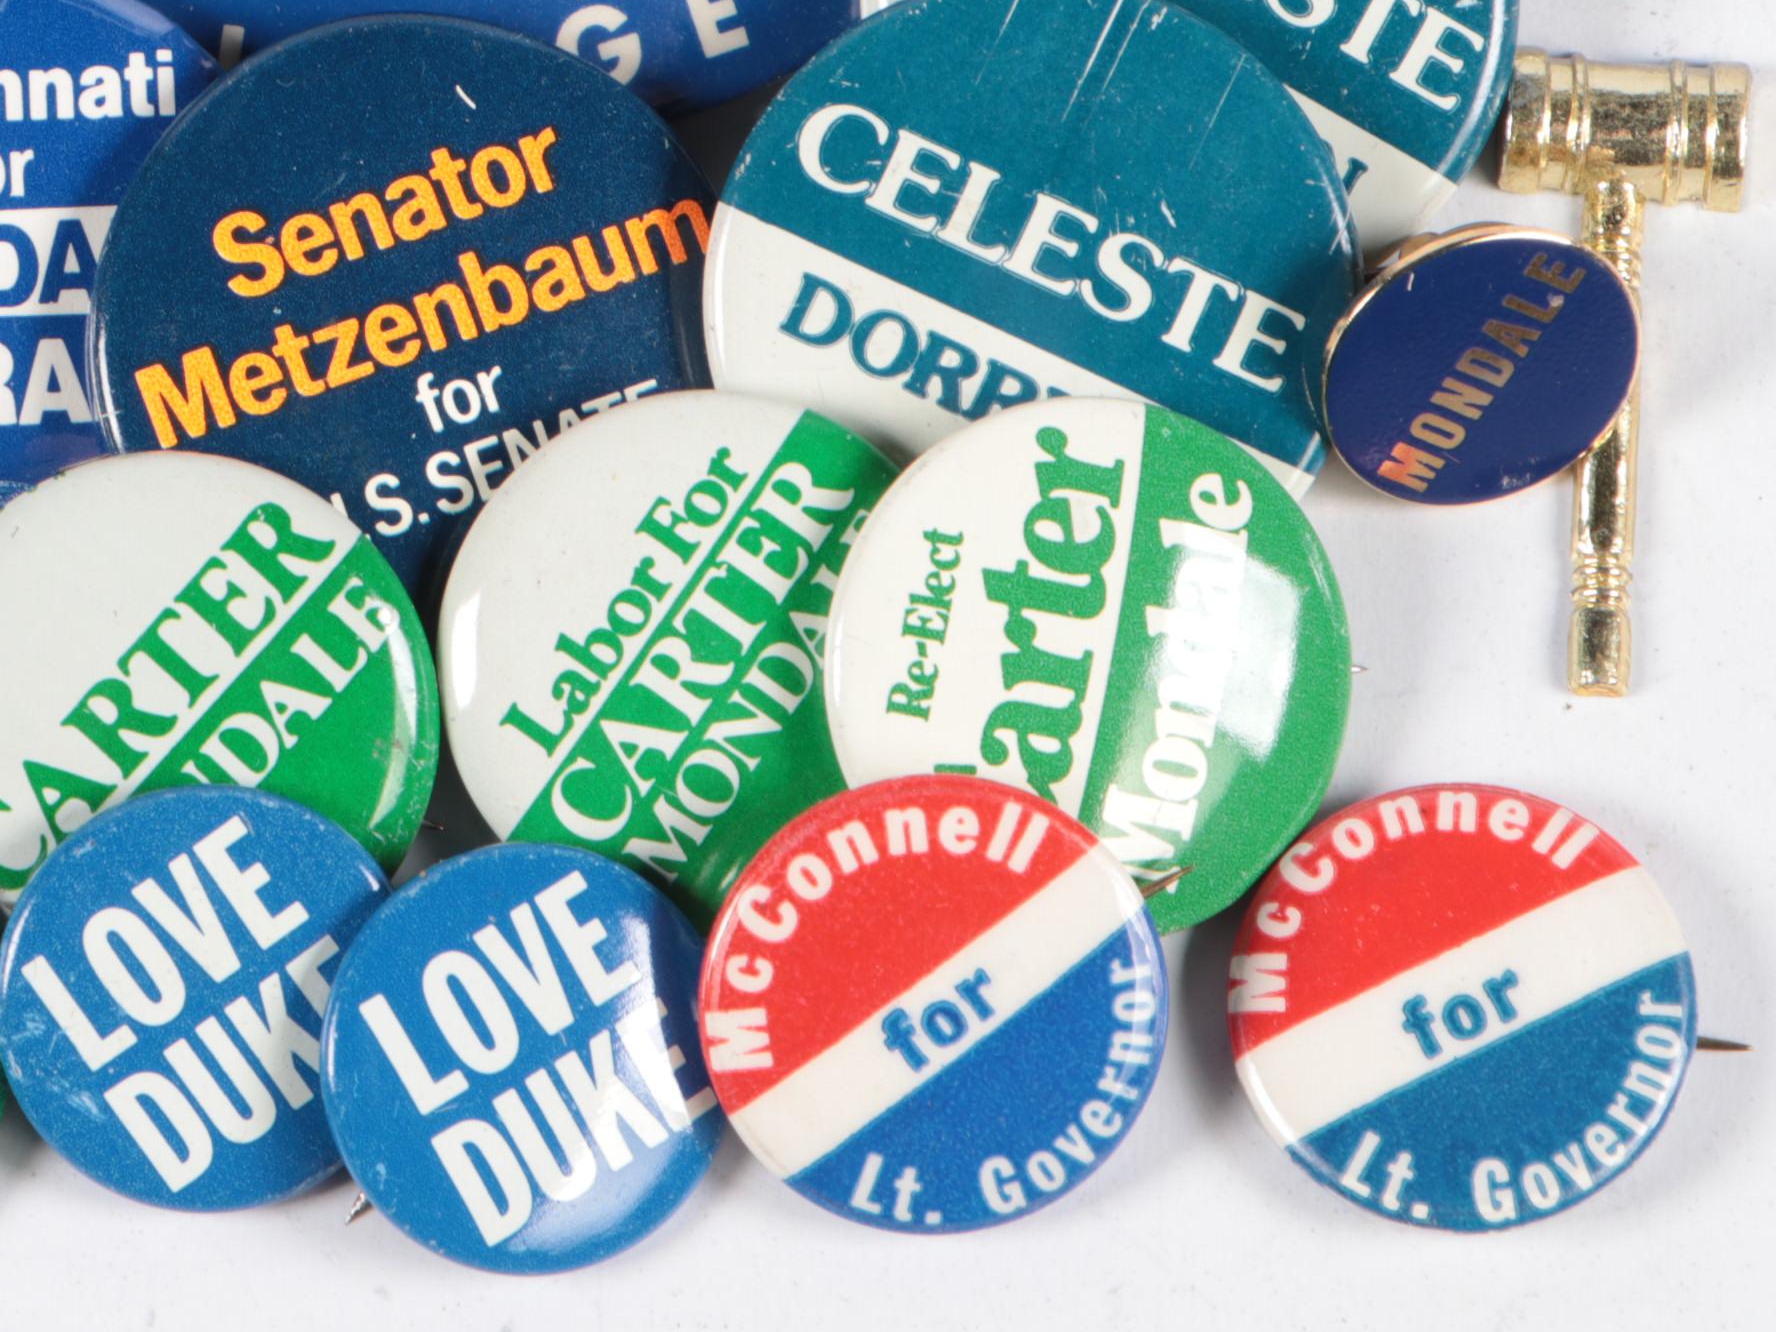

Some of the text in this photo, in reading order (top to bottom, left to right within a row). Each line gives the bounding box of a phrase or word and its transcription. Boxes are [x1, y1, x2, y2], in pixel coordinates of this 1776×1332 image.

[134, 198, 710, 450] Metzenbaum
[213, 126, 558, 298] Senator
[797, 103, 1307, 394] CELESTE
[416, 366, 502, 434] for
[779, 272, 1066, 422] DORR
[1377, 252, 1585, 493] MONDALE
[500, 446, 749, 758] Labor For
[551, 462, 856, 841] CARTER
[886, 527, 964, 722] Re-Elect
[21, 815, 309, 1072] LOVE
[359, 870, 642, 1115] LOVE
[705, 801, 1050, 1073] McConnell
[880, 967, 995, 1072] for
[1228, 790, 1600, 1014] McConnell
[1401, 969, 1519, 1059] for
[431, 997, 714, 1248] DUKE
[849, 958, 1157, 1225] Lt. Governor
[1341, 990, 1684, 1222] Lt. Governor
